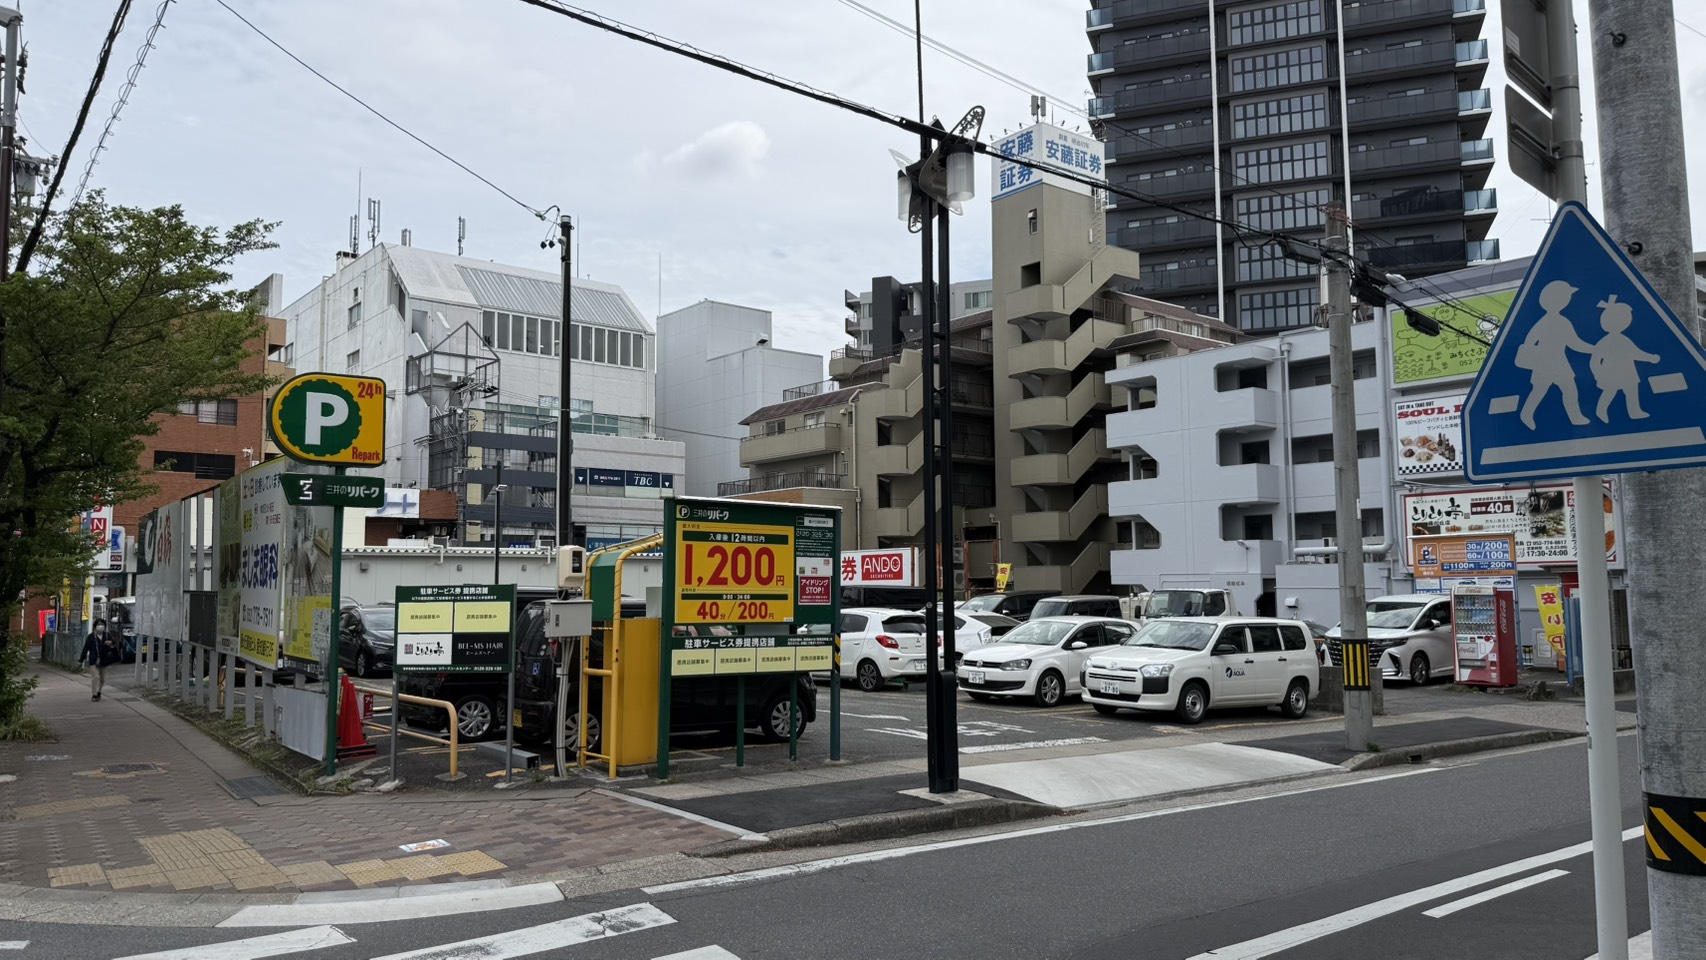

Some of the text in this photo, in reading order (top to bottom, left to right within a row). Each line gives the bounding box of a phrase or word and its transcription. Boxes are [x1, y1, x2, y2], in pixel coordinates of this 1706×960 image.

[1046, 140, 1101, 174] 安藤証券
[1450, 347, 1488, 359] みちくさふ
[358, 382, 382, 399] 24h
[305, 391, 349, 445] P
[1397, 406, 1450, 419] SOUL
[352, 447, 380, 461] Repark
[634, 477, 652, 485] TBC
[326, 485, 379, 497] 三井のリパーク
[693, 509, 729, 520] 三井のリパーク
[1412, 497, 1463, 520] とりとり亭
[242, 542, 279, 590] まじま眼科
[684, 544, 784, 587] 1,200円
[842, 556, 857, 581] 券
[863, 556, 901, 573] ANDO
[420, 587, 488, 595] 駐車サービス券 提携店舗
[684, 637, 775, 648] 駐車サービス券提携店舗
